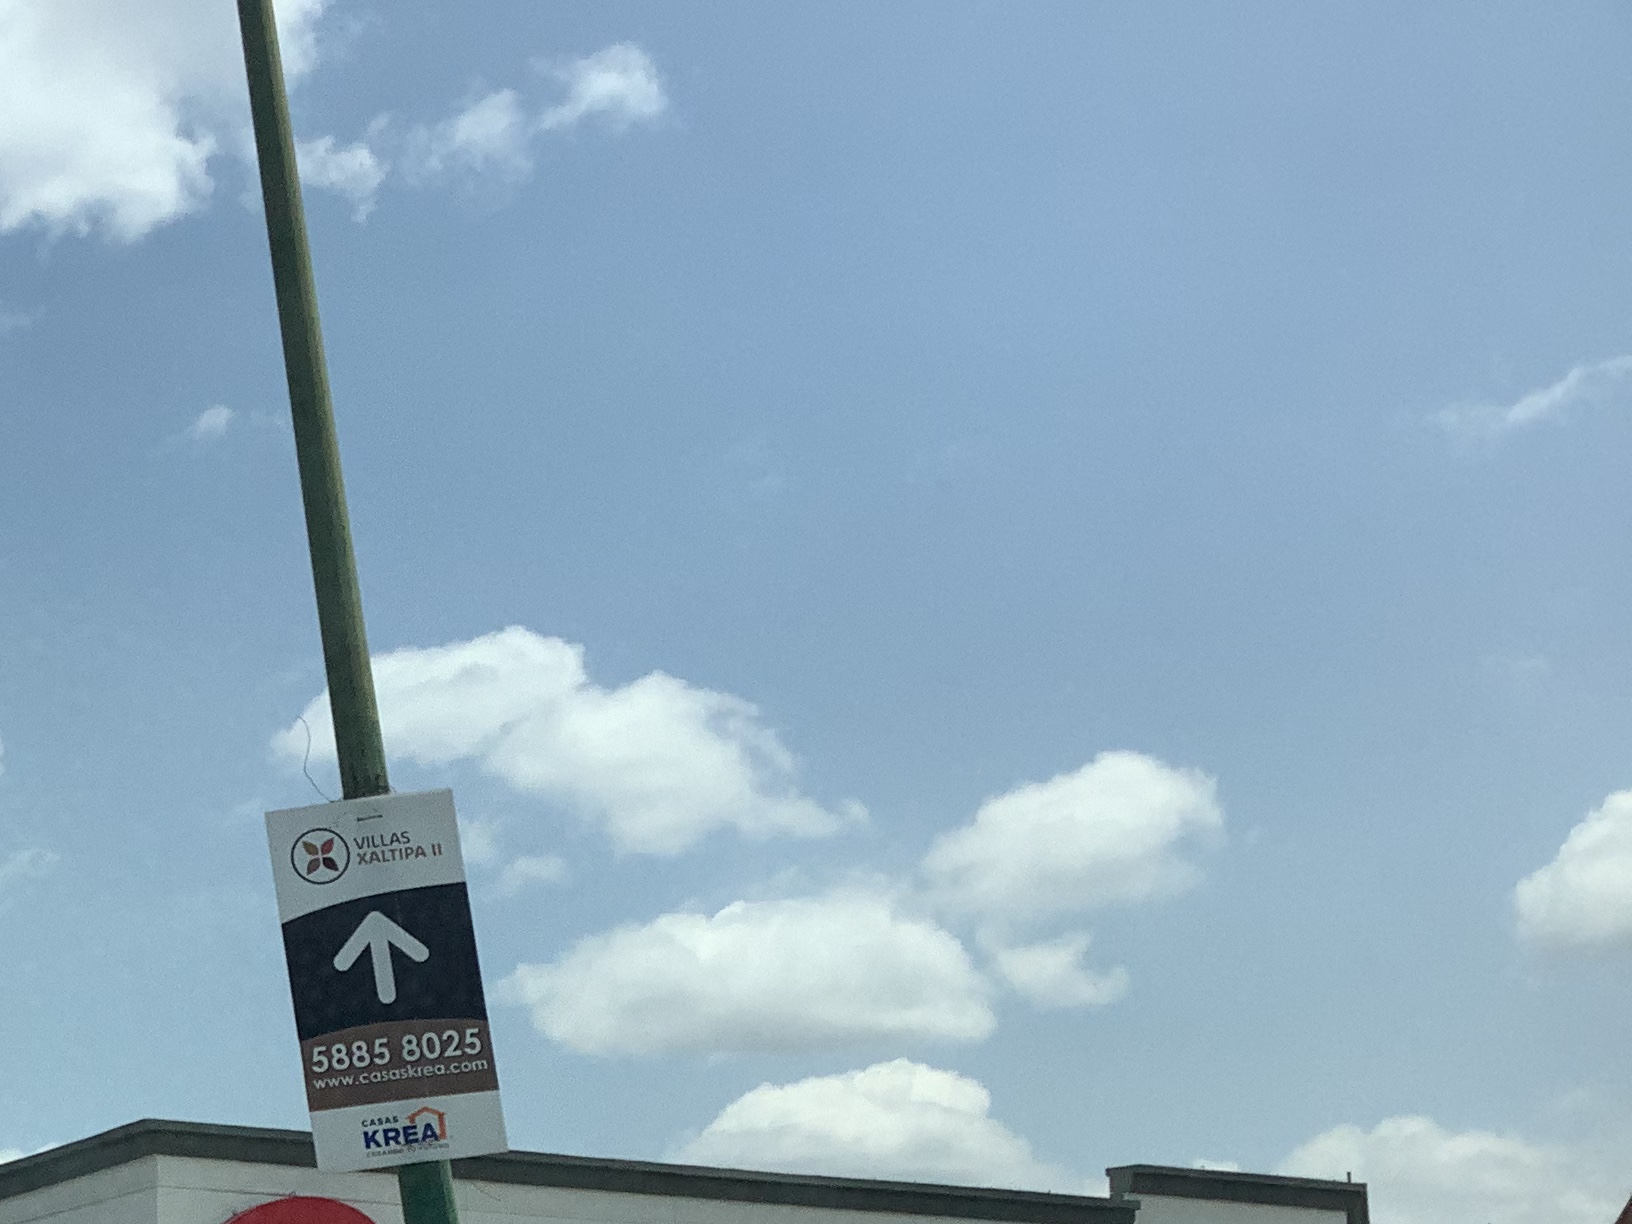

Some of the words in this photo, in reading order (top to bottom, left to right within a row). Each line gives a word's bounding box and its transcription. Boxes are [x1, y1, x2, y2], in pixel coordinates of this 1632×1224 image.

[353, 830, 411, 850] VILLAS
[355, 844, 427, 866] XALTIPA
[431, 842, 443, 858] II
[311, 1037, 391, 1073] 5885
[401, 1028, 482, 1062] 8025
[312, 1059, 489, 1090] www.casaskrea.com
[361, 1115, 399, 1128] CASAS
[362, 1122, 441, 1150] KREA
